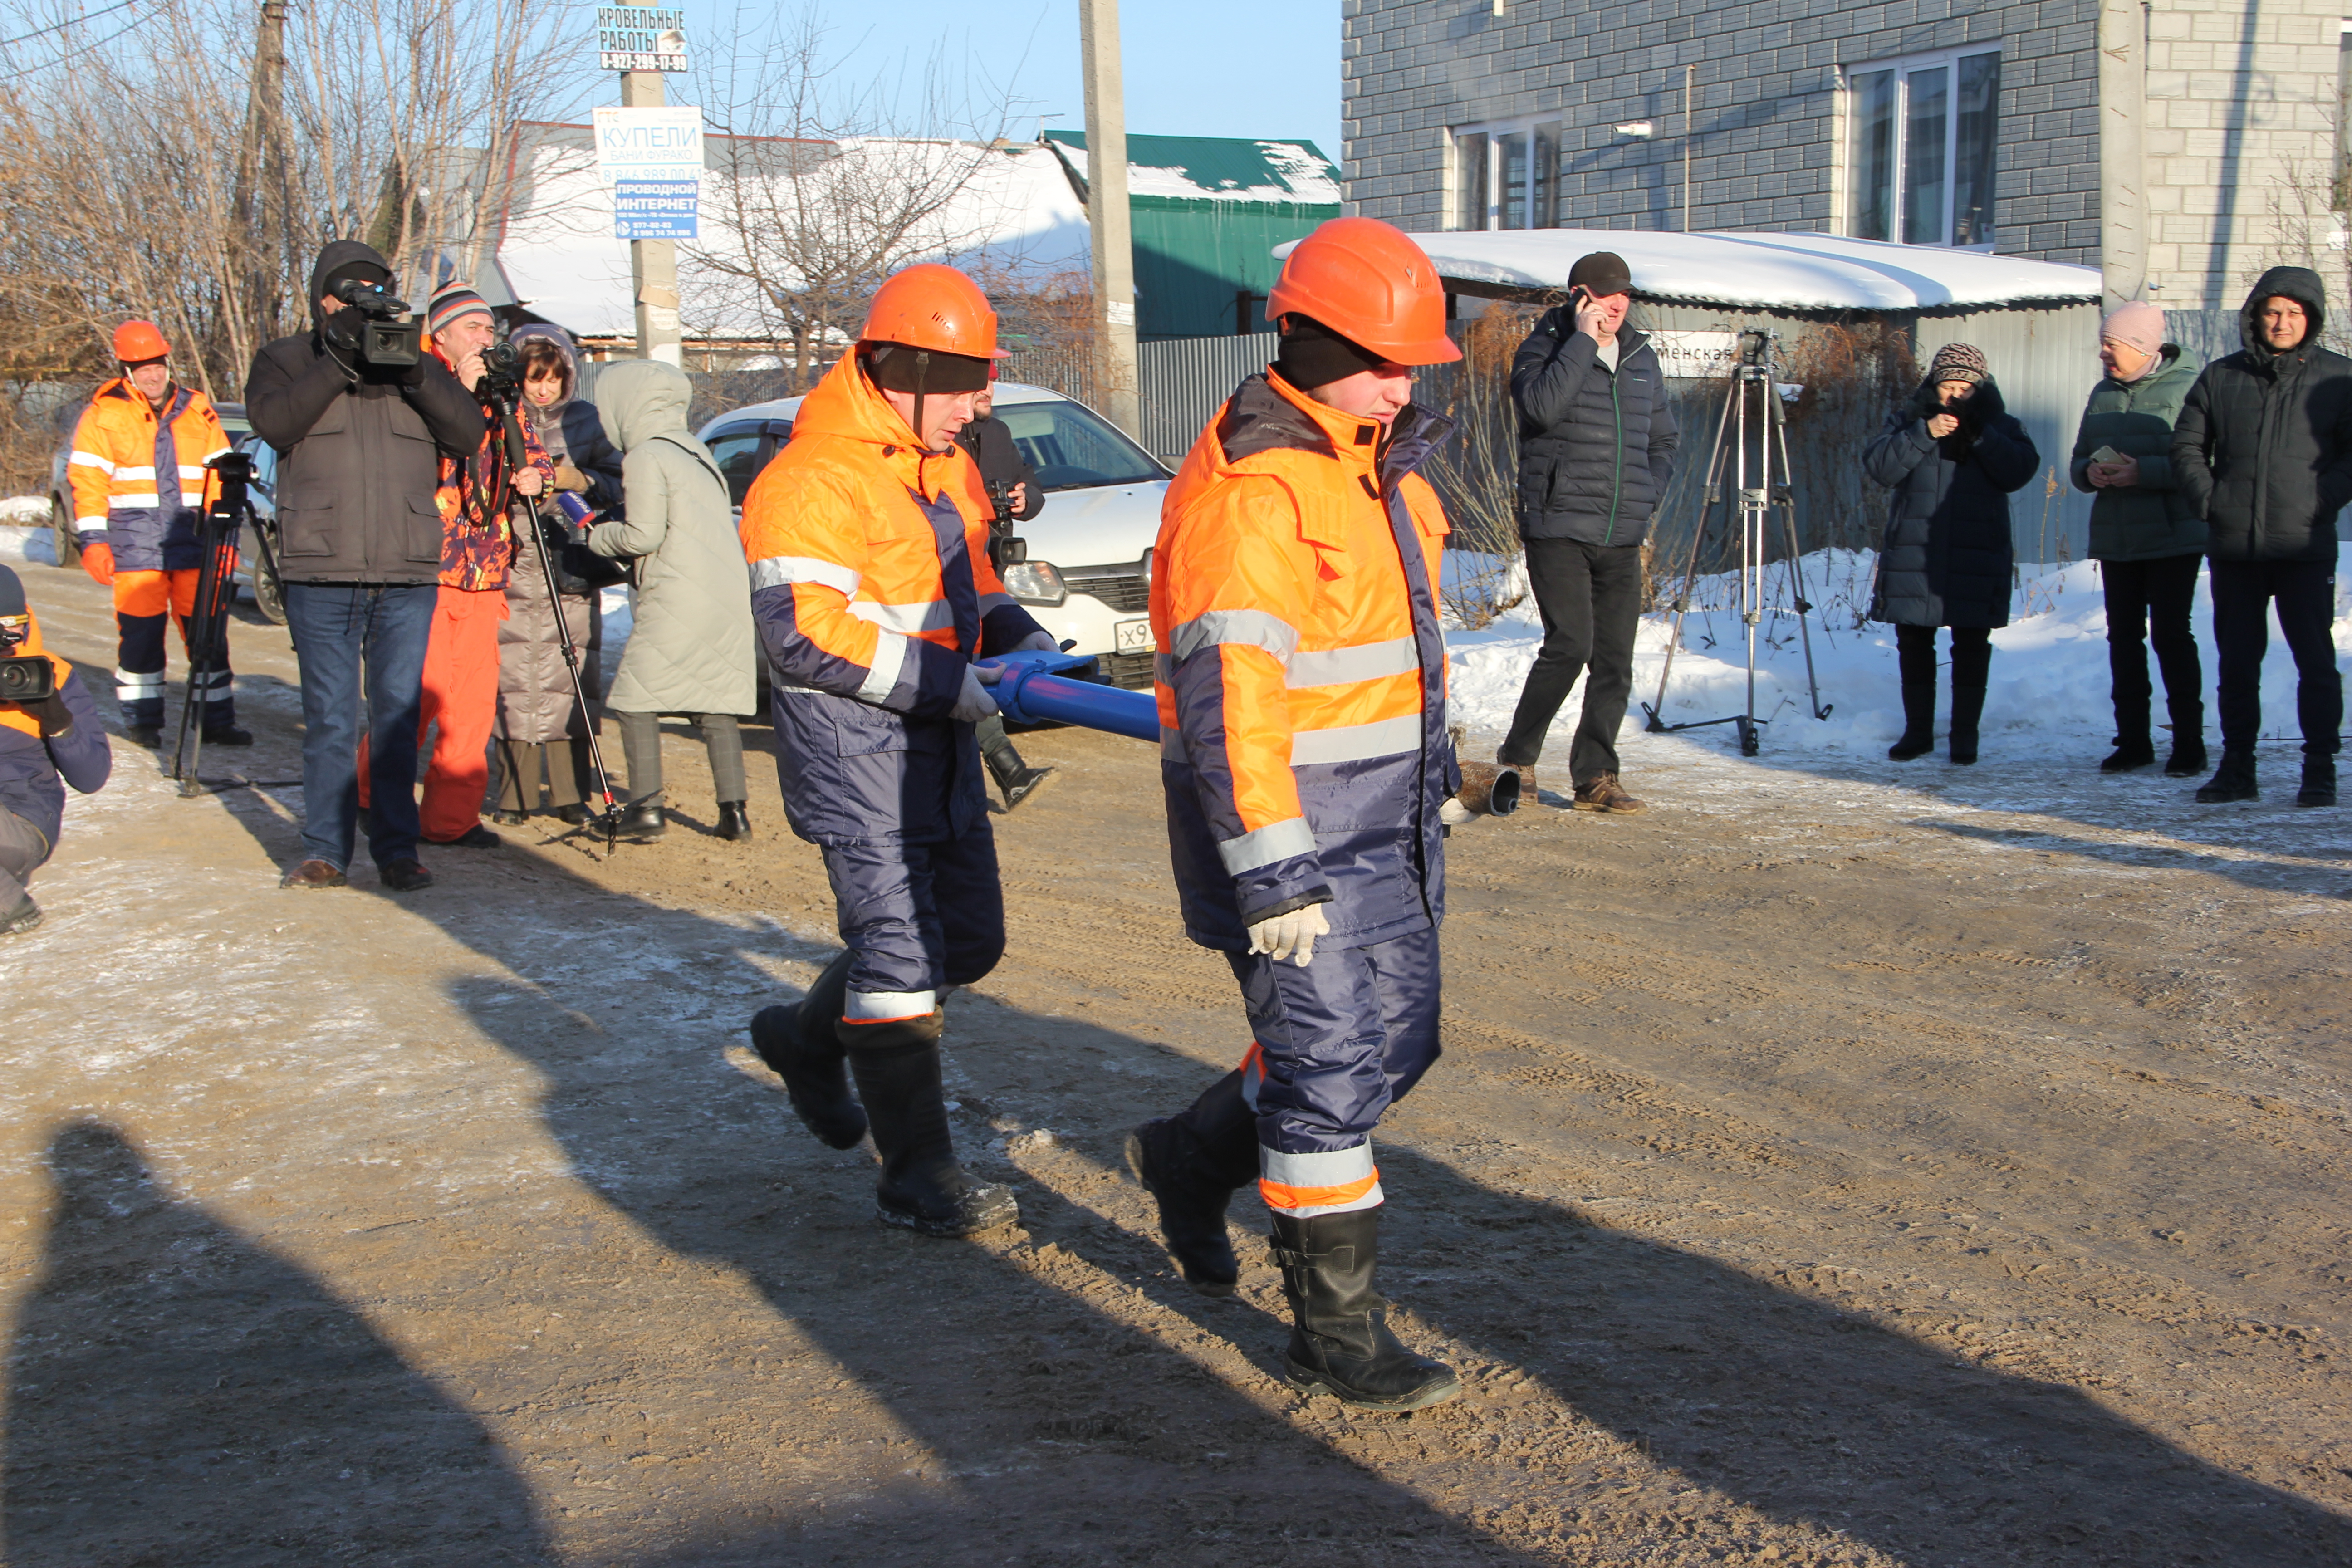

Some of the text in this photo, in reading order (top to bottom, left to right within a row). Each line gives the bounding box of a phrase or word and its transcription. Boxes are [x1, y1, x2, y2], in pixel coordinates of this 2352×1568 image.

[598, 7, 685, 30] КРОВЕЛЬНЫЕ
[600, 30, 658, 52] РАБОТЫ
[601, 53, 687, 70] 8-927-299-17-99
[602, 127, 697, 147] КУПЕЛИ
[610, 149, 693, 160] БАНИ ФУРАКО
[603, 169, 611, 182] 8
[617, 182, 696, 196] ПРОВОДНОЙ
[617, 198, 696, 210] ИНТЕРНЕТ
